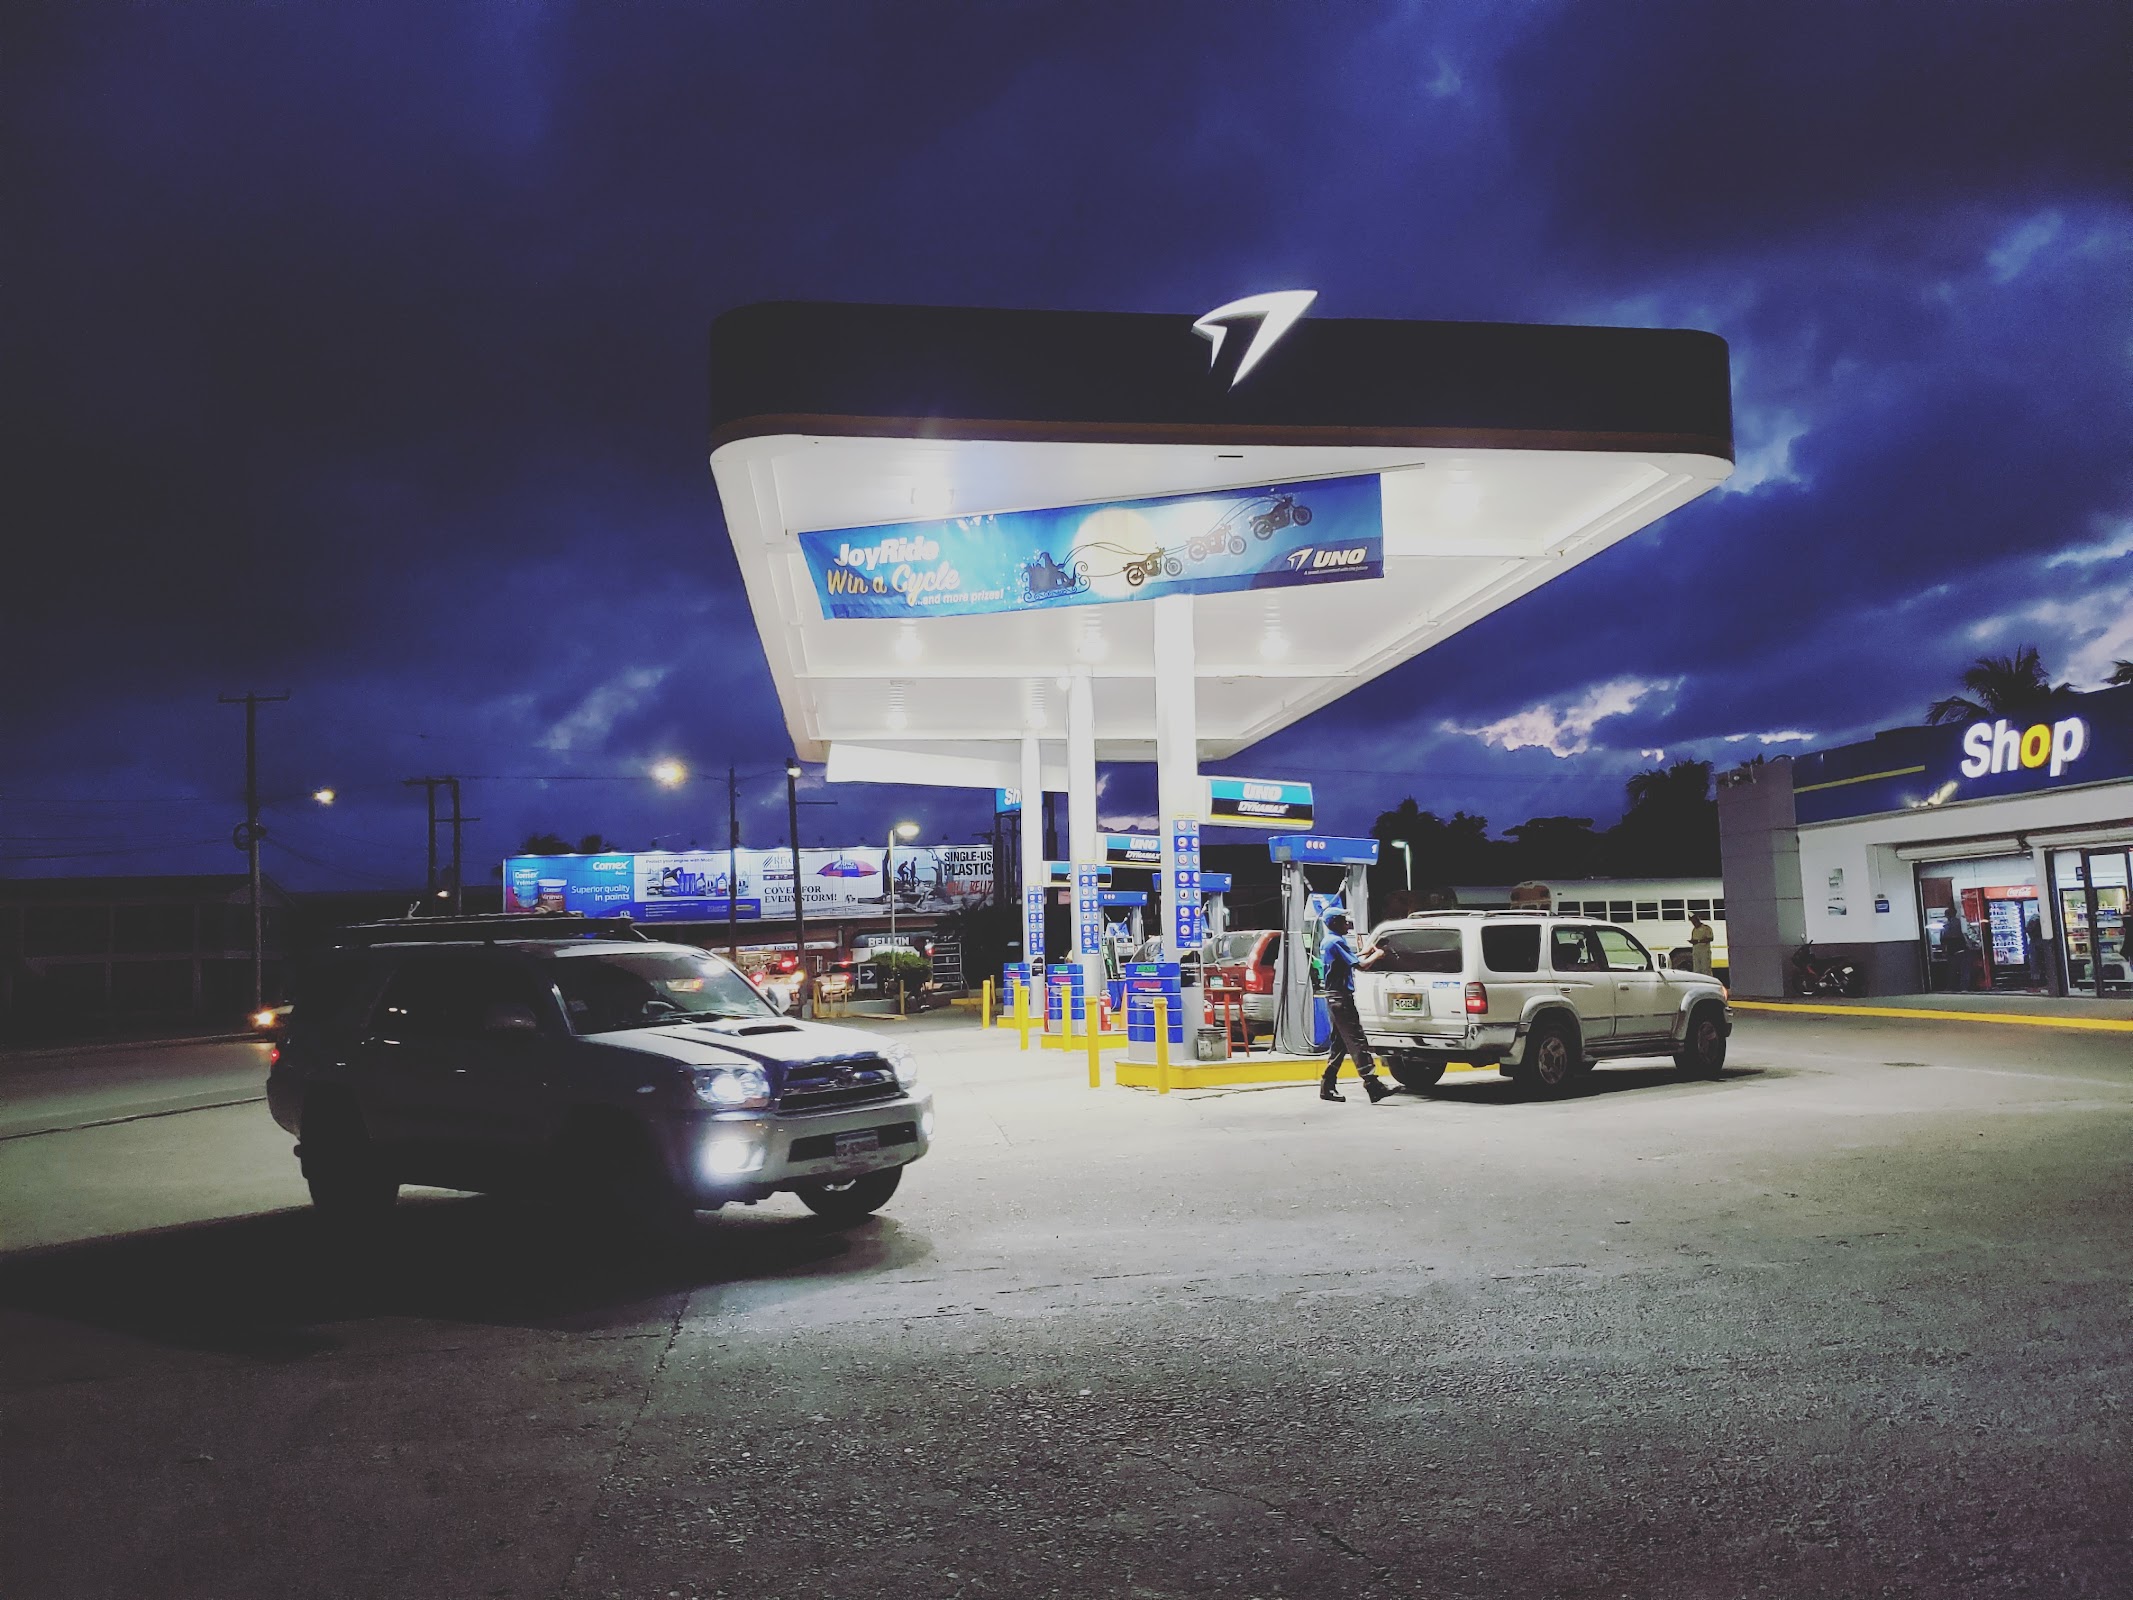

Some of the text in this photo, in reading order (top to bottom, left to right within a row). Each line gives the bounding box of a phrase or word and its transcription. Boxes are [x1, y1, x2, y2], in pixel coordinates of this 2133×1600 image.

[833, 536, 940, 570] JoyRide
[1313, 548, 1368, 568] UNO
[827, 560, 961, 607] Win a Cycle
[942, 594, 969, 604] more
[971, 588, 1004, 604] prizes!
[1961, 717, 2085, 778] Shop
[1243, 783, 1283, 801] UNO
[1238, 801, 1290, 815] DYNAMAX
[1129, 837, 1158, 850] UNO
[1371, 844, 1378, 855] 1
[944, 851, 993, 862] SINGLE-US
[592, 860, 630, 871] Comex
[944, 862, 993, 876] PLASTIC
[571, 884, 631, 895] Superior quality
[801, 885, 821, 894] FOR
[604, 893, 630, 903] paints
